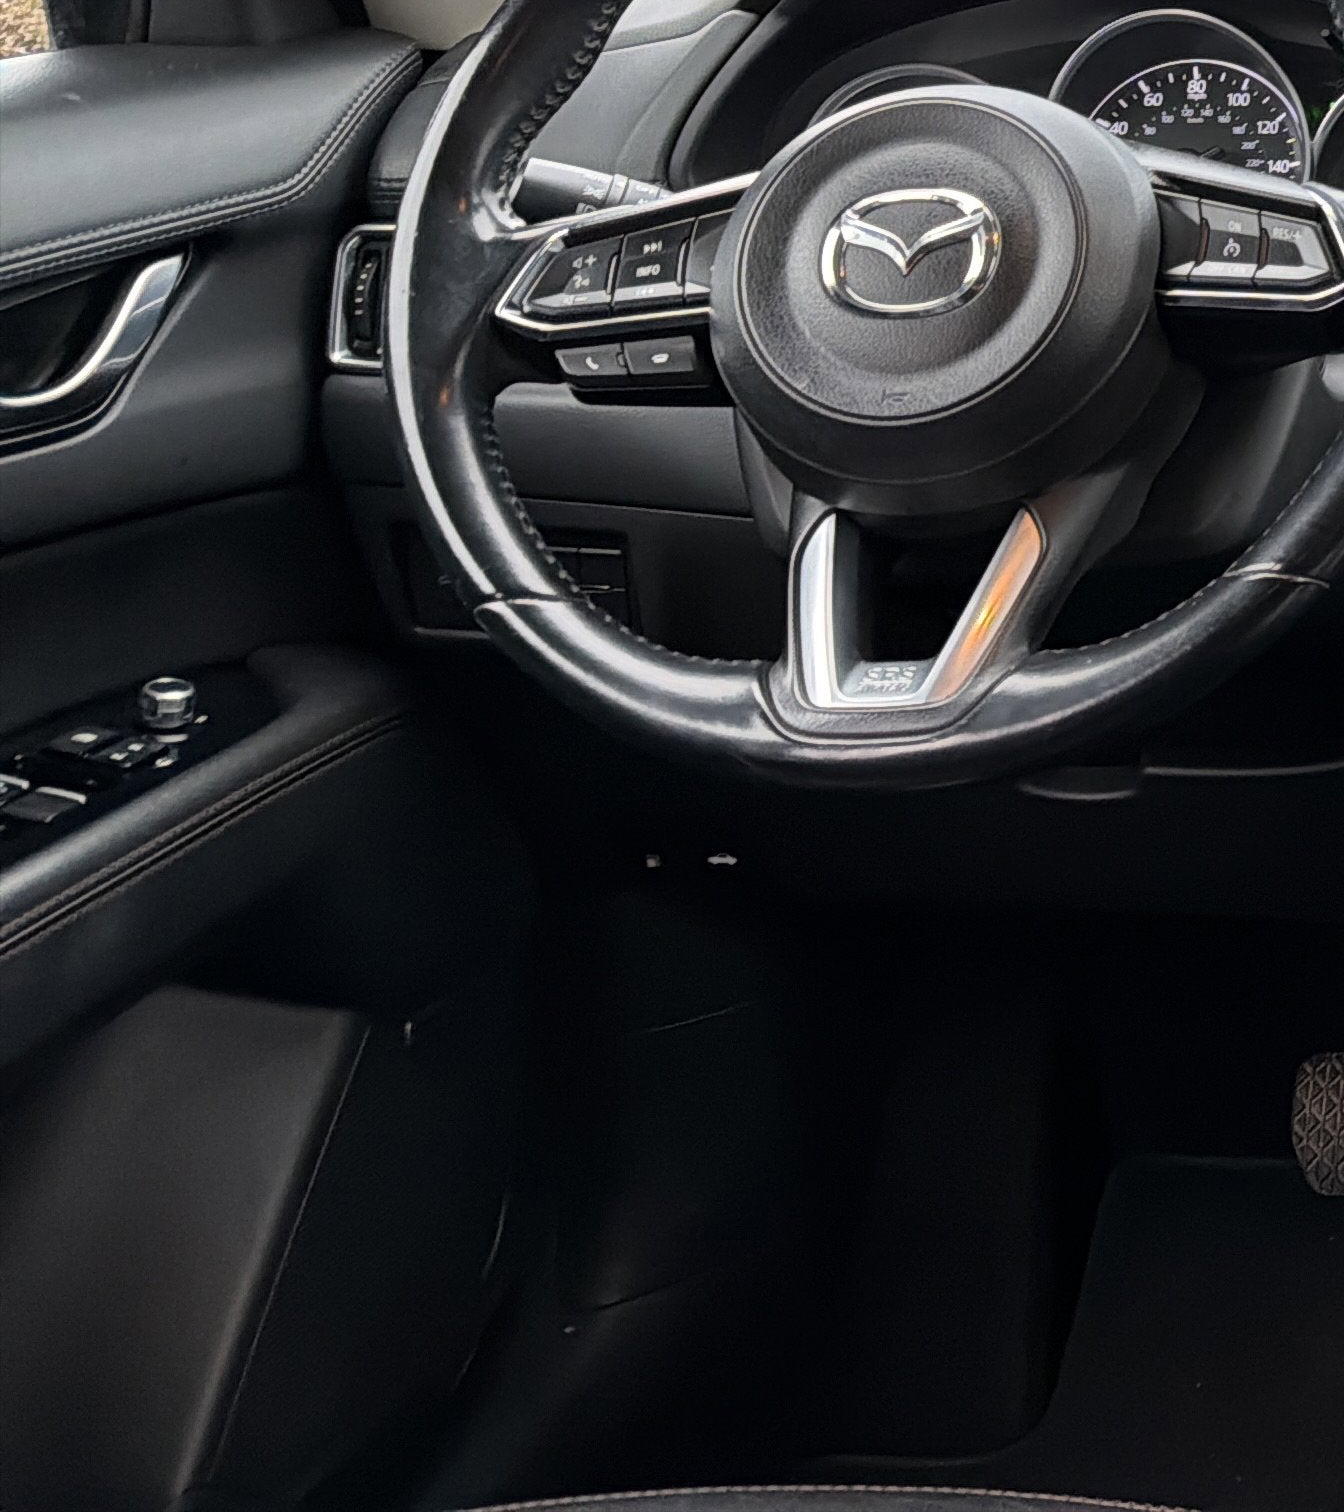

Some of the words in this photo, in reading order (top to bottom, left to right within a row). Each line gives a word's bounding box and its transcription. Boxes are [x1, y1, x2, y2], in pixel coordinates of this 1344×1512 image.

[1186, 79, 1207, 94] 80
[1143, 93, 1164, 107] 60
[1226, 92, 1251, 107] 100
[1109, 121, 1129, 135] 40
[1256, 121, 1280, 135] 120
[1266, 159, 1290, 174] 140
[1228, 220, 1242, 233] ON
[635, 263, 661, 278] INFO
